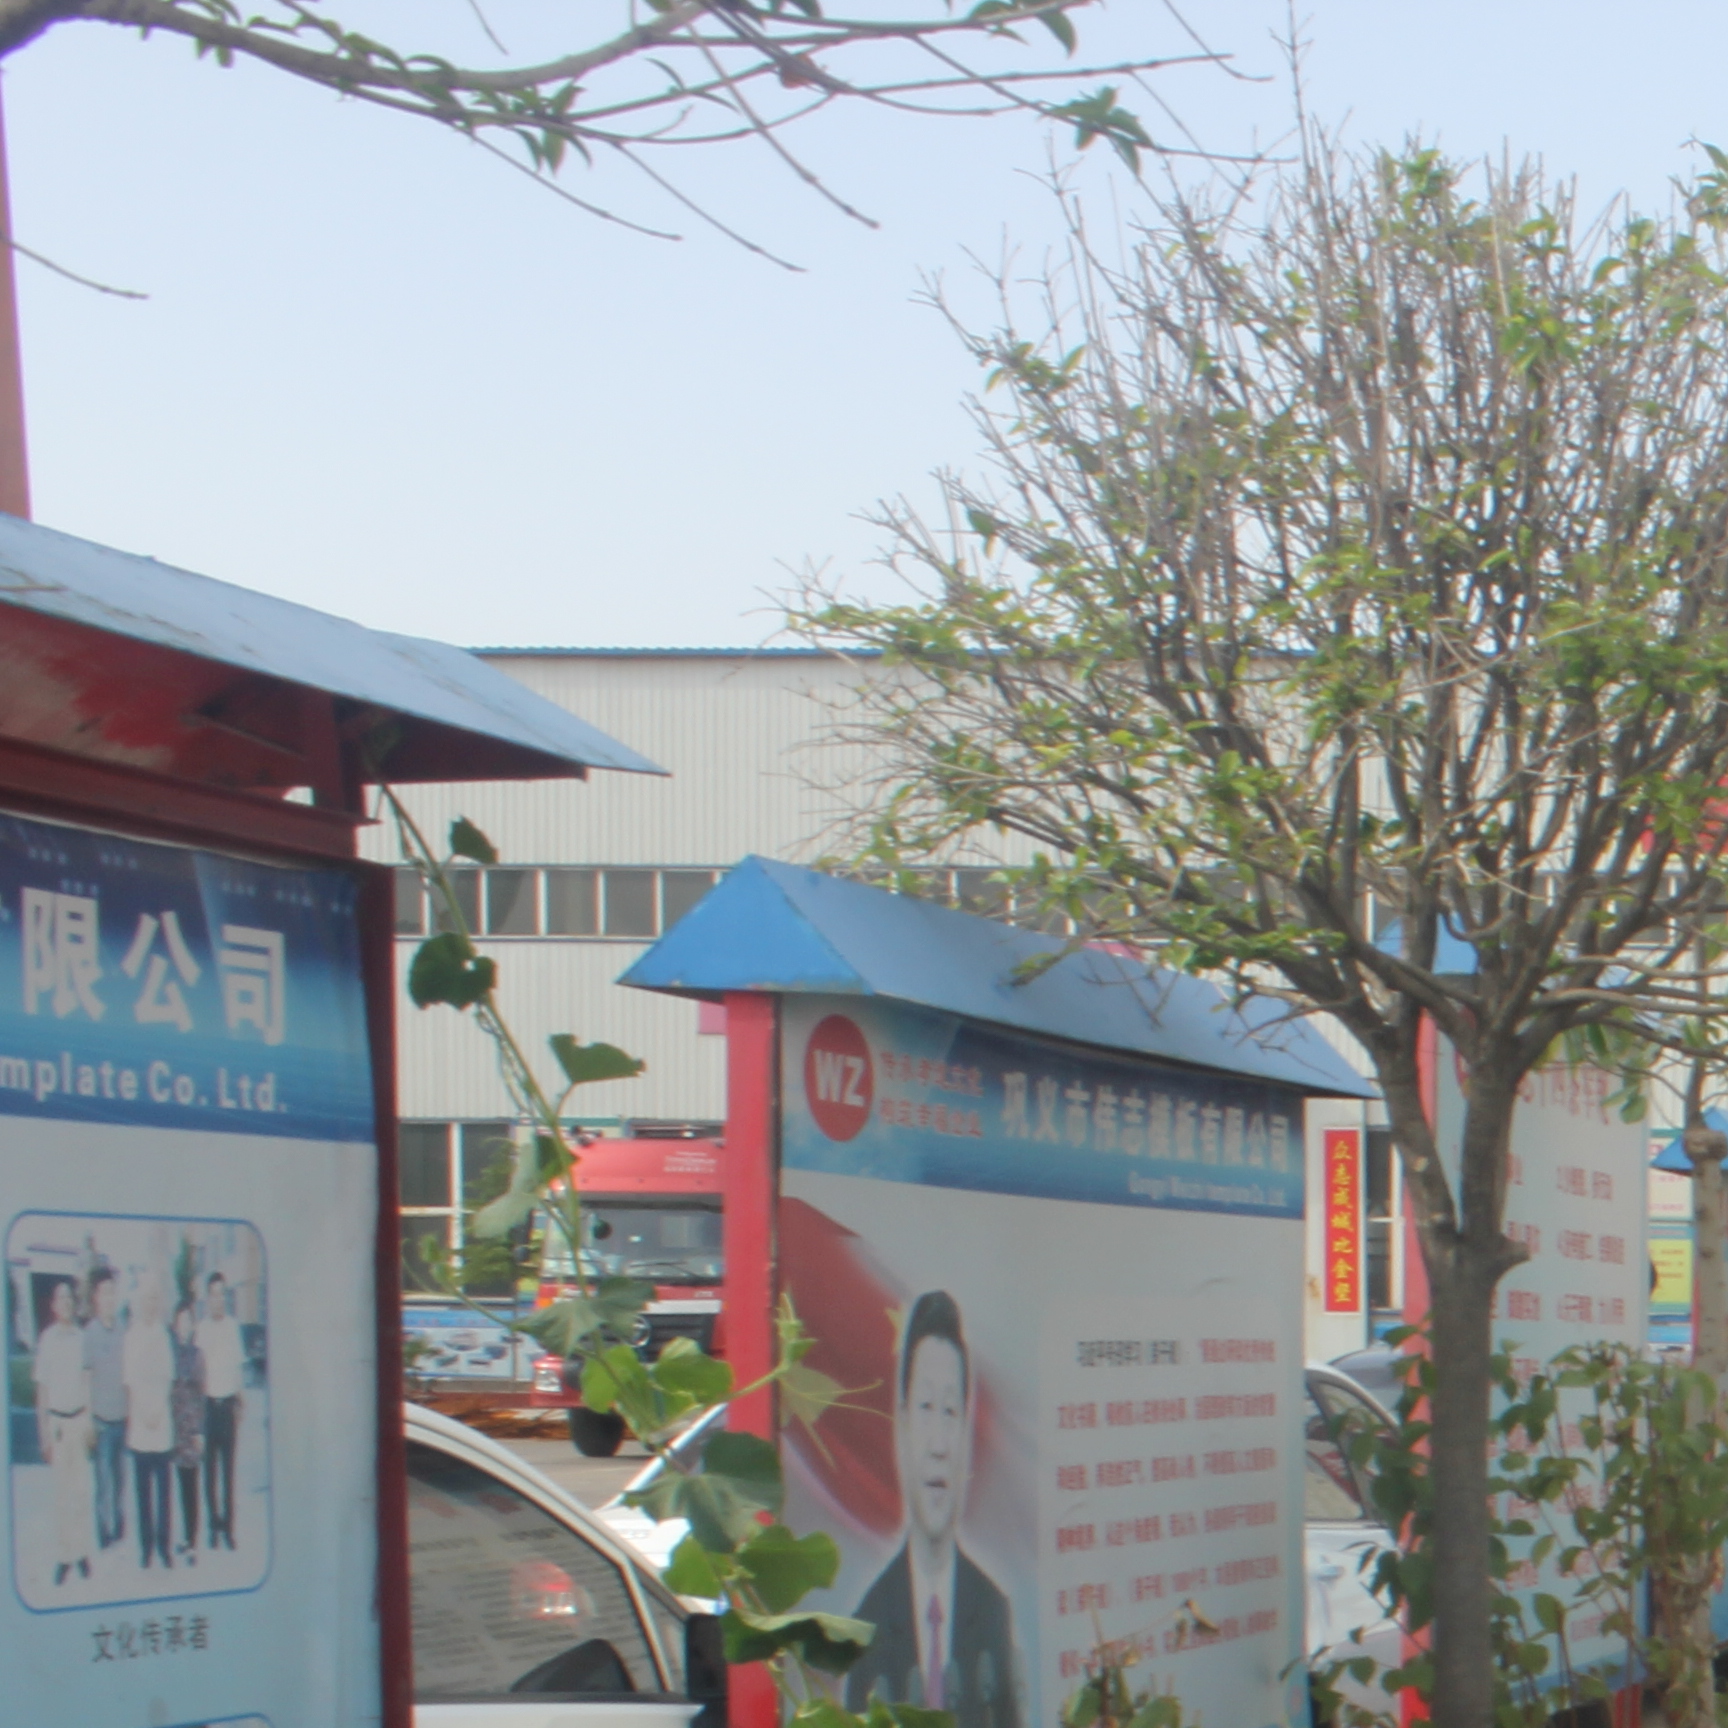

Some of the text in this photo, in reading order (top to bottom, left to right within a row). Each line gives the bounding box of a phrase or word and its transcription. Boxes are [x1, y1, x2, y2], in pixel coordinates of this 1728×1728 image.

[20, 885, 286, 1047] 限公司
[0, 1051, 139, 1102] mplate
[216, 1066, 288, 1113] Ltd.
[813, 1048, 867, 1109] WZ
[1003, 1070, 1290, 1175] 巩义市伟志模板有限公司
